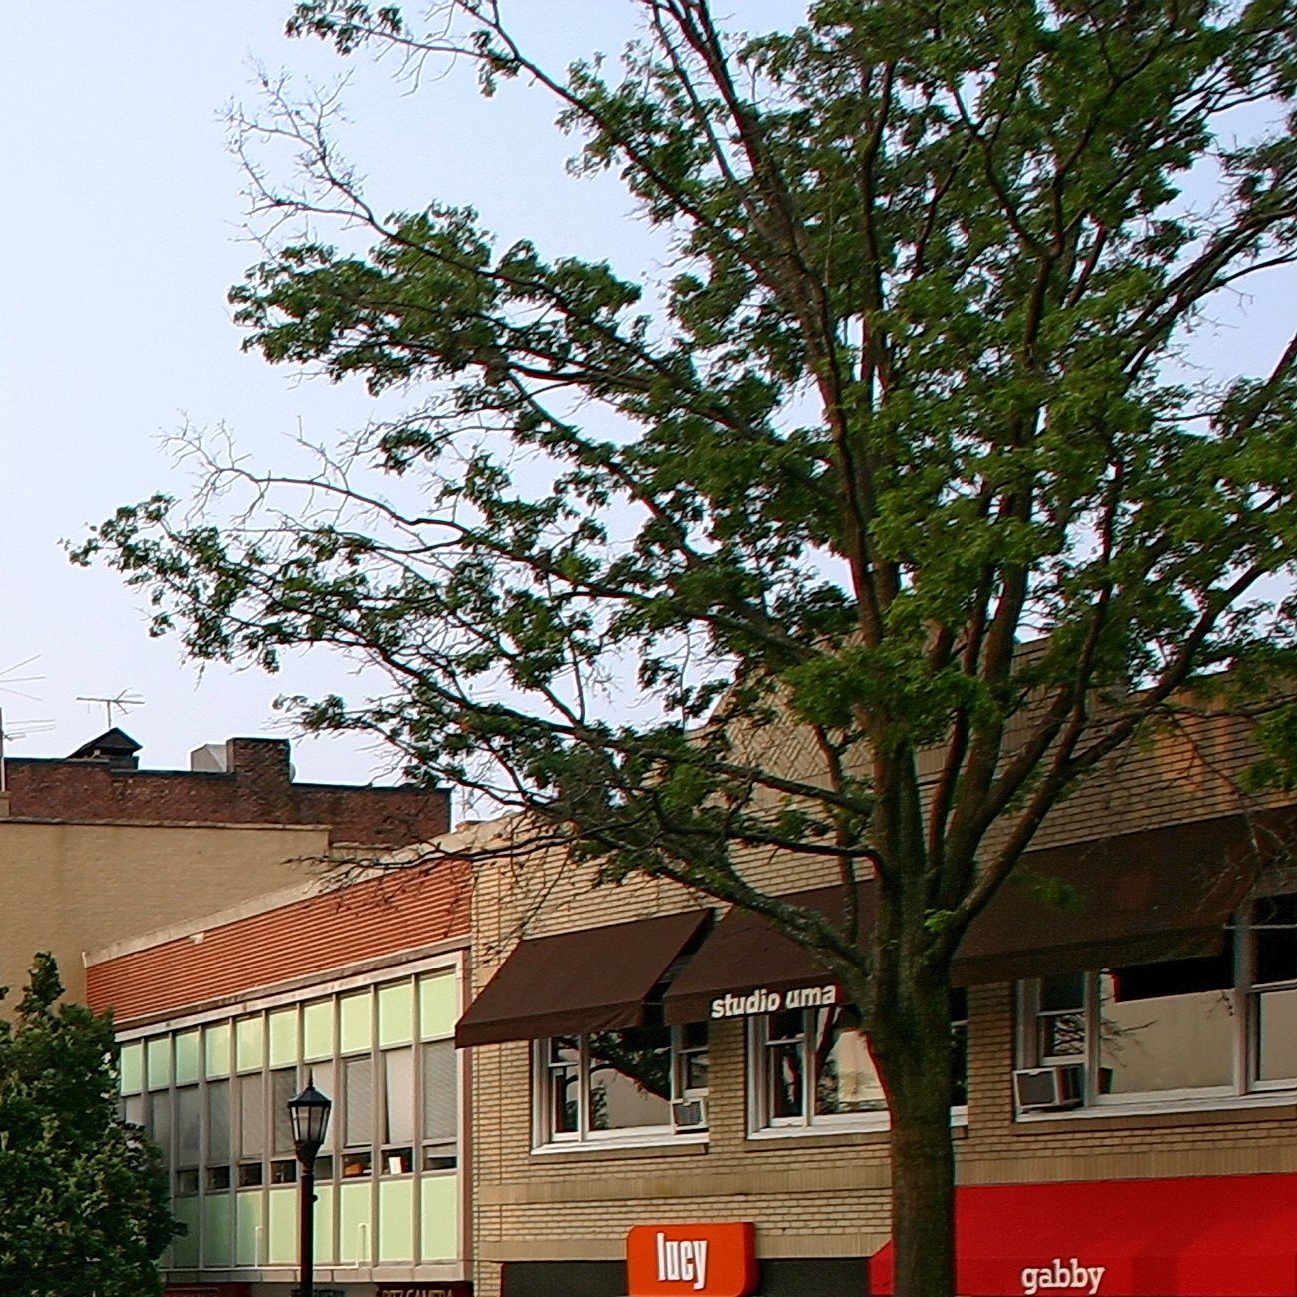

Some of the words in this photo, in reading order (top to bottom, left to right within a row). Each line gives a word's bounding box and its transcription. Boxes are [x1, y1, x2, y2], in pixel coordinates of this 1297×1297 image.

[711, 988, 781, 1018] studio
[785, 984, 837, 1009] uma
[656, 1232, 707, 1290] lucy
[1021, 1258, 1106, 1295] gabby
